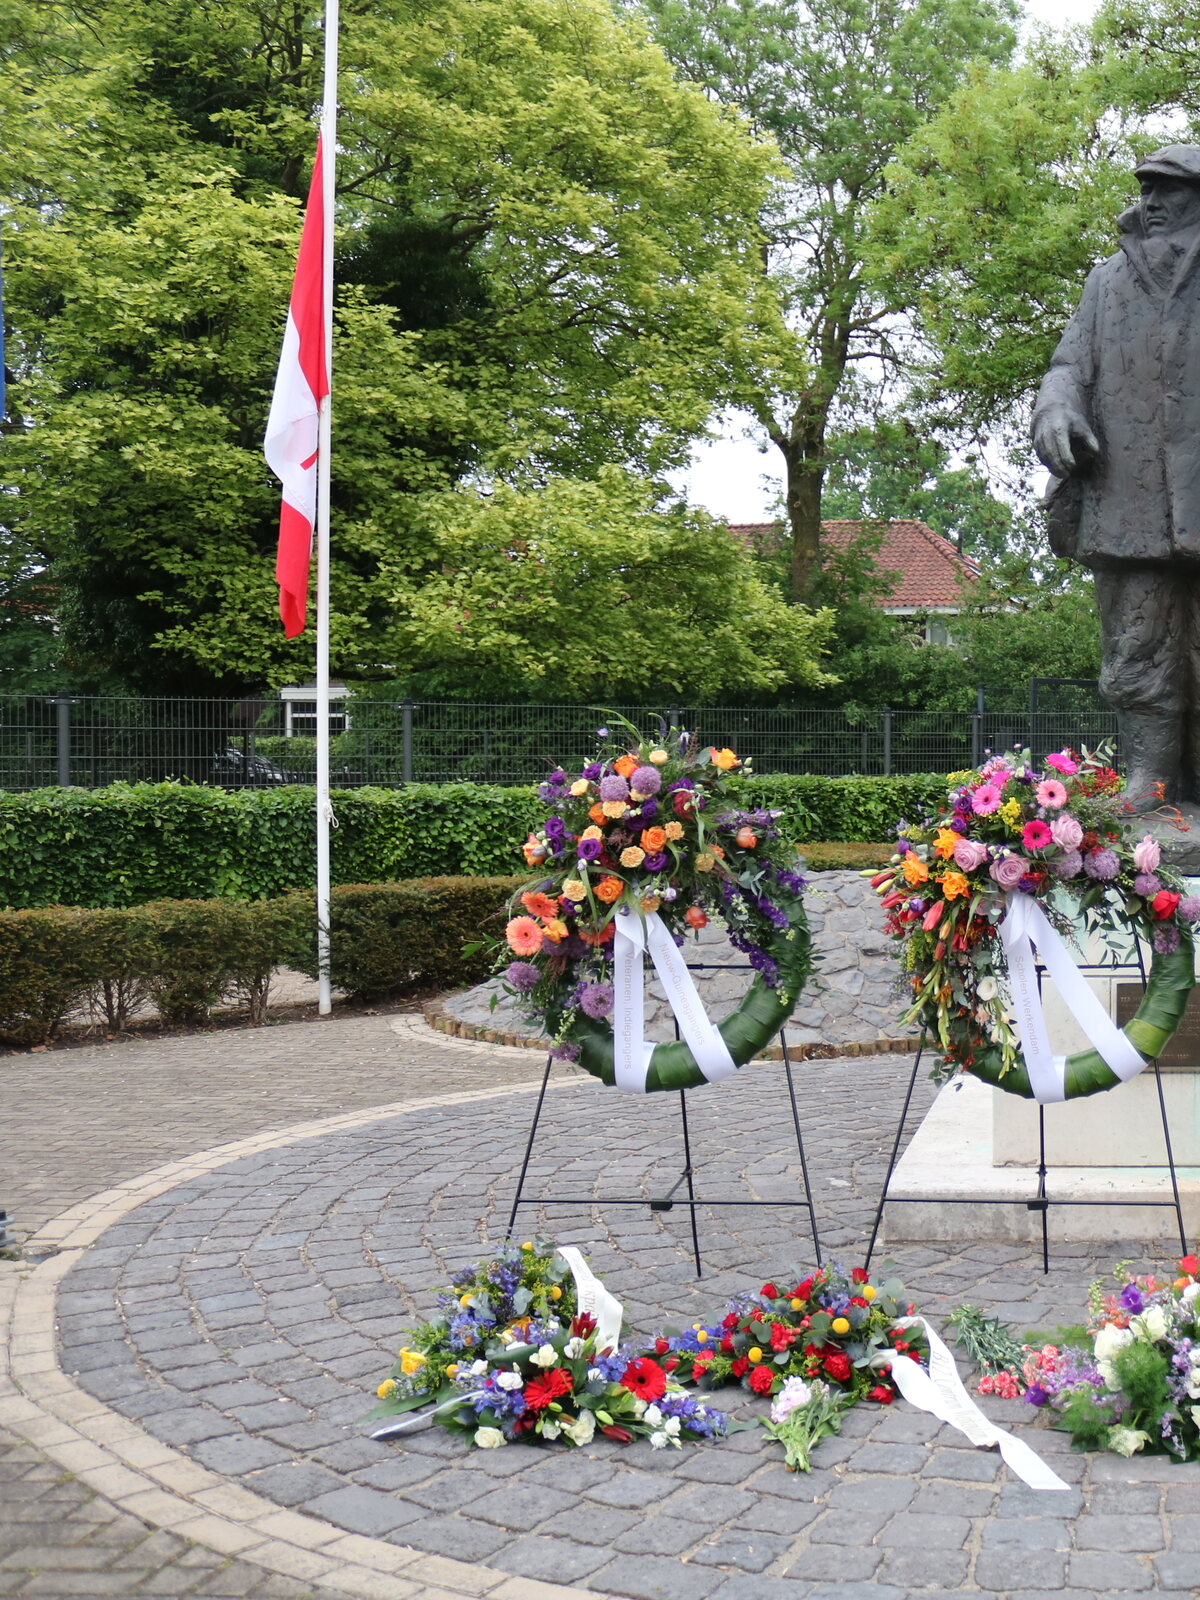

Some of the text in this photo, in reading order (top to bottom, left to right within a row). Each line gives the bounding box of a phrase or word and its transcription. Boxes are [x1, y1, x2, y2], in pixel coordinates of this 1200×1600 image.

[622, 952, 635, 1070] Veteranen, Indiegangers
[658, 943, 705, 1046] Nieuw-Guineagangers
[1014, 955, 1040, 1055] Scholen Werkendam
